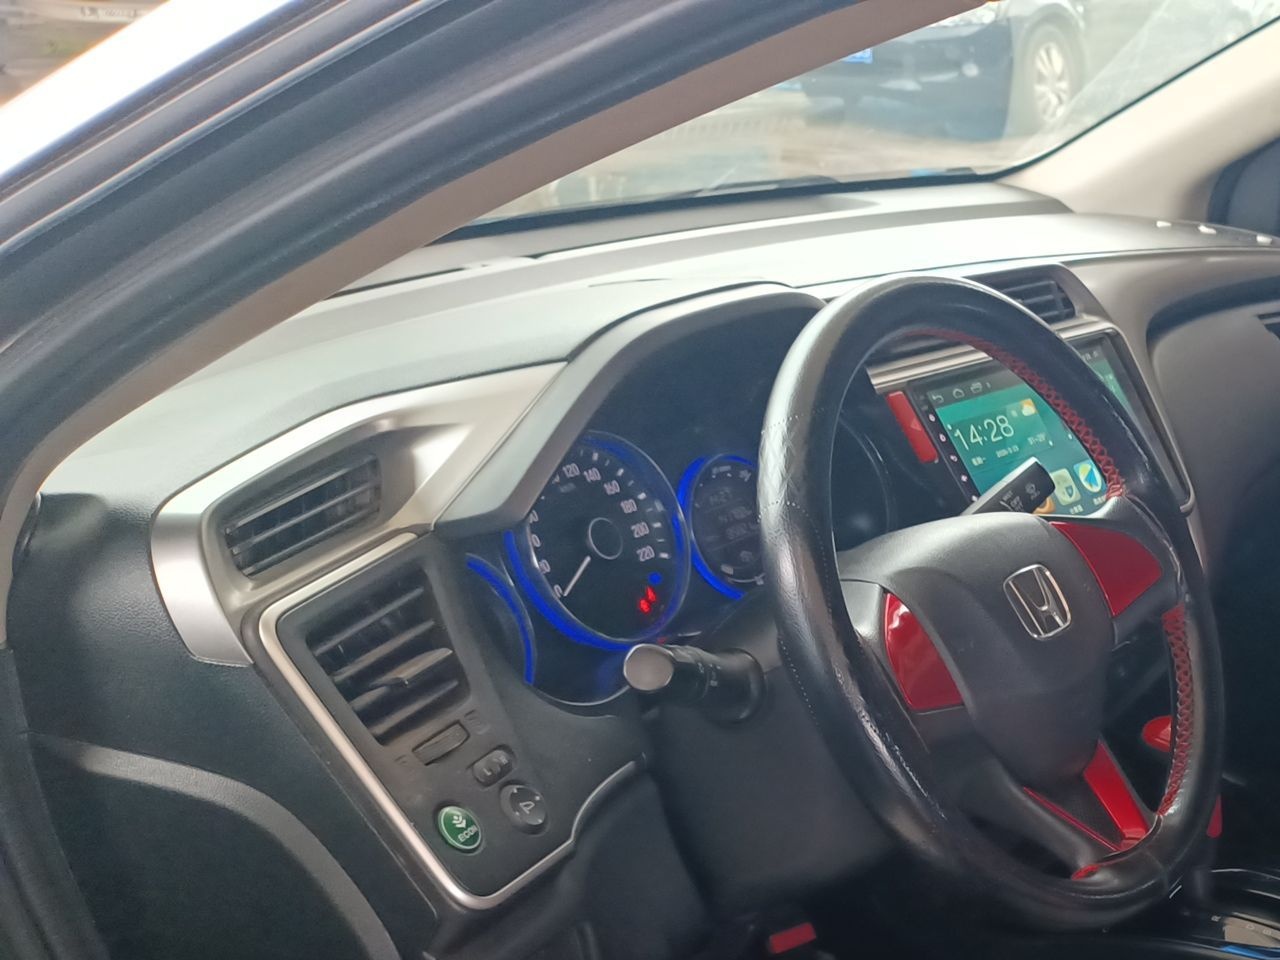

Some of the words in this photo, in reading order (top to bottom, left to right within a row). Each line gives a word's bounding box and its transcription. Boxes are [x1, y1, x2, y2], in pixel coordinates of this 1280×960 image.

[954, 415, 1015, 451] 14:28
[562, 463, 580, 478] 120
[583, 467, 601, 482] 140
[603, 480, 620, 495] 160
[620, 499, 638, 514] 180
[631, 521, 650, 538] 200
[636, 545, 655, 562] 220
[458, 825, 478, 842] ECON
